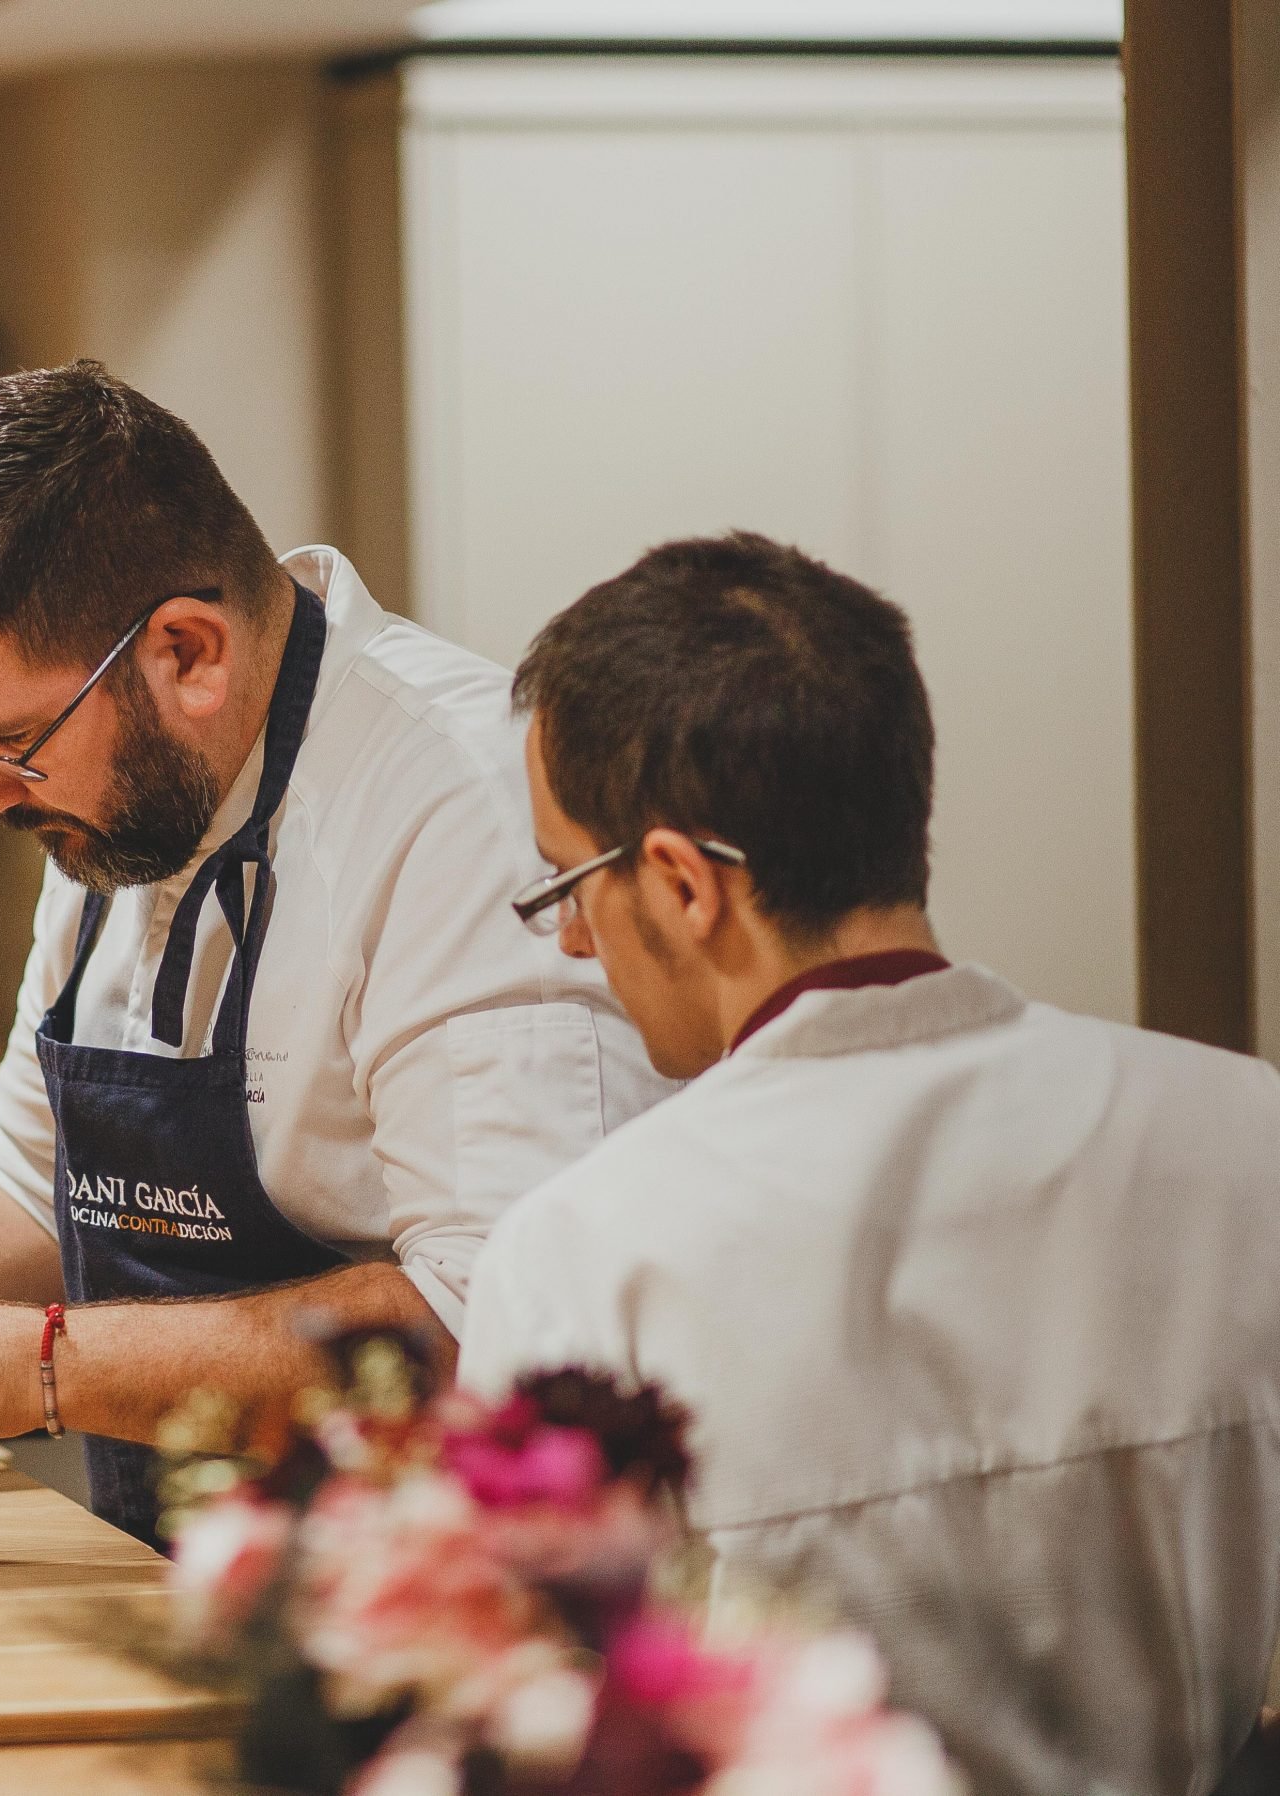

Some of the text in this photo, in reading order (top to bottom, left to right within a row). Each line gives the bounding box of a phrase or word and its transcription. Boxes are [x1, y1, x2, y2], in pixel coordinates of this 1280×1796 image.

[246, 1087, 265, 1104] RCÍA
[135, 1181, 225, 1219] GARCÍA
[70, 1206, 232, 1241] OCINACONTRADICIÓN
